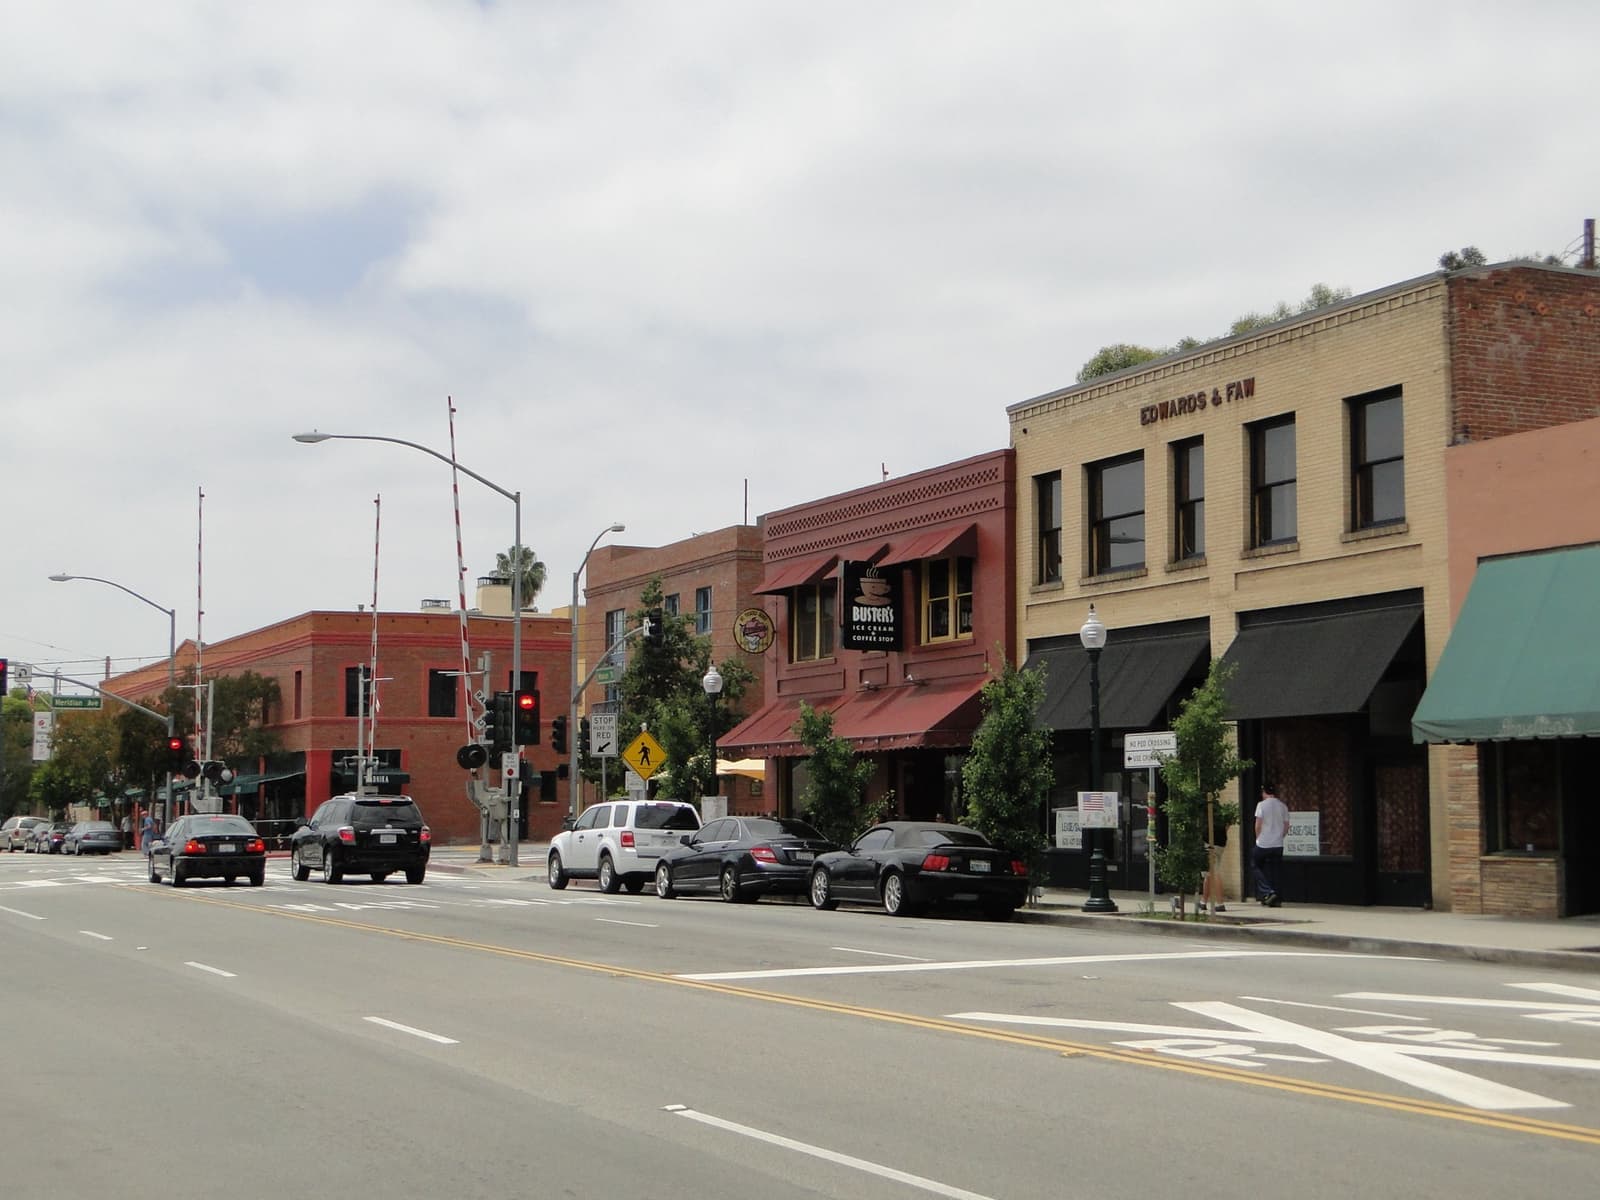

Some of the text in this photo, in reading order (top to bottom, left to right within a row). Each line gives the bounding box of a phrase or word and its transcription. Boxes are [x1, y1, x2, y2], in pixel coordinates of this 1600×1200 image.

[1140, 377, 1255, 426] EDWARDS & FAW
[852, 606, 894, 623] BUSTER'S
[55, 698, 83, 706] Meridian
[593, 716, 614, 724] STOP
